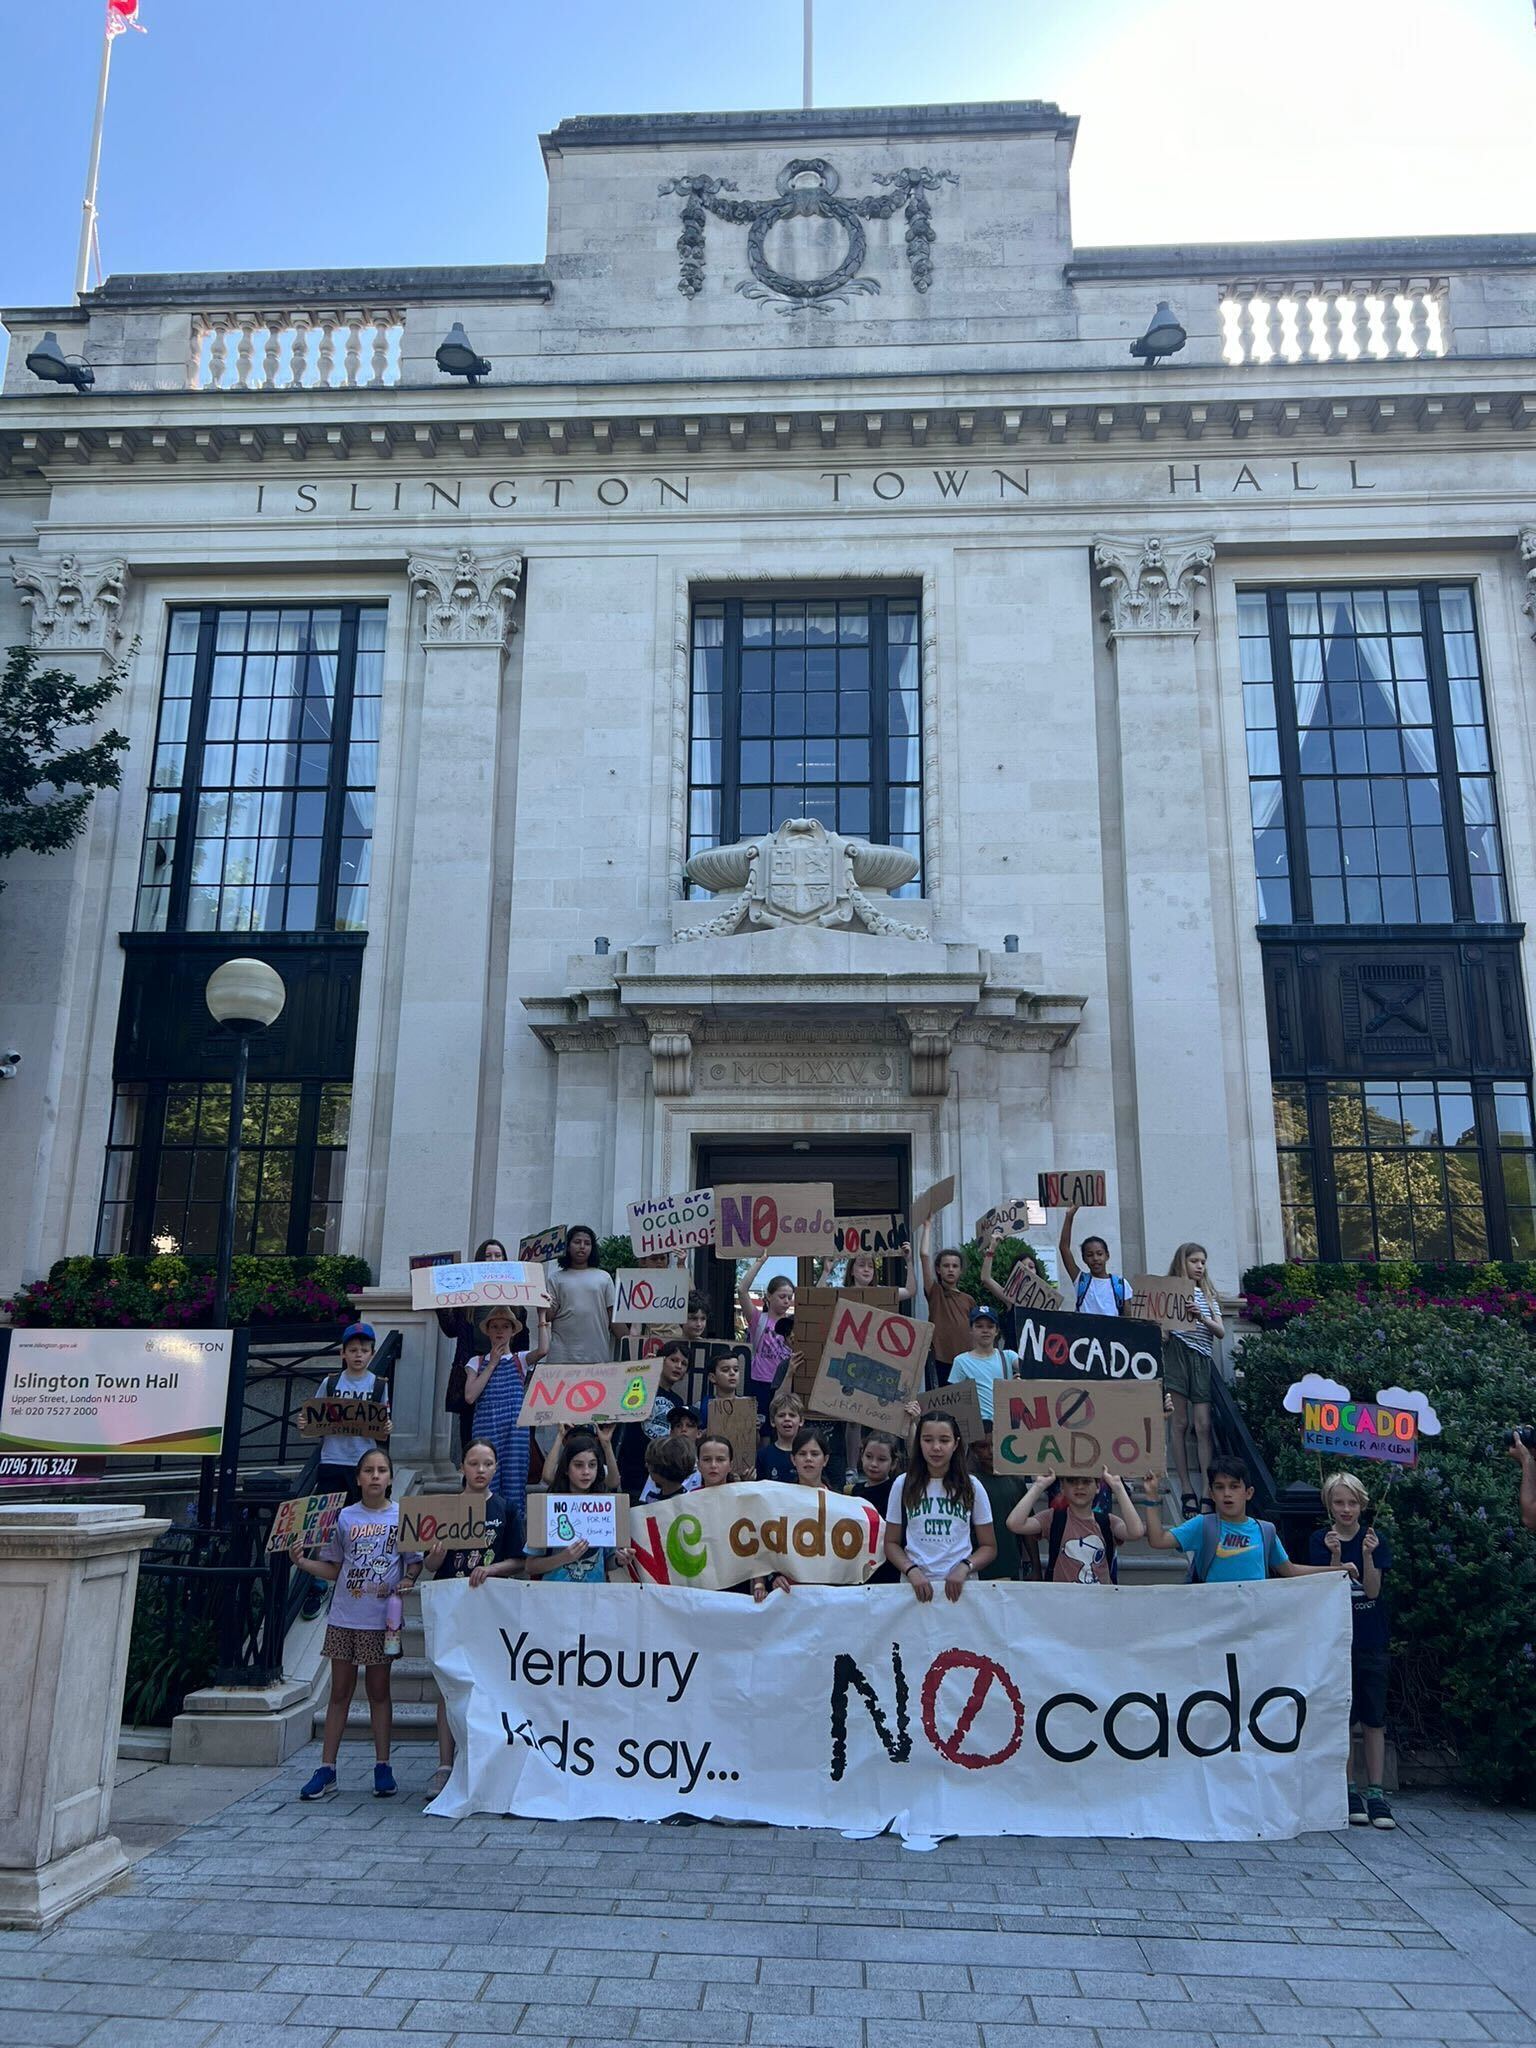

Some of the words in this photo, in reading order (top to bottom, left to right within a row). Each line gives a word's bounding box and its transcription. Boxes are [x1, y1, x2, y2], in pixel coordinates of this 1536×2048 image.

[255, 476, 690, 513] ISLINGTON
[820, 468, 1031, 502] TOWN
[1166, 459, 1377, 494] HALL
[634, 1197, 675, 1217] What
[684, 1192, 712, 1204] are
[436, 1291, 480, 1305] OCADO
[483, 1283, 536, 1300] OUT
[1018, 1318, 1158, 1381] NOCADO
[13, 1373, 89, 1392] Islington
[95, 1373, 141, 1389] Town
[146, 1373, 179, 1389] Hall
[12, 1394, 37, 1406] Upper
[38, 1394, 68, 1405] Street,
[70, 1394, 102, 1404] London
[104, 1394, 116, 1404] N1
[118, 1394, 138, 1404] 2UD
[25, 1407, 44, 1416] 020
[47, 1407, 71, 1416] 7527
[73, 1407, 98, 1416] 2000
[1304, 1402, 1415, 1441] NOCADO
[1306, 1432, 1341, 1446] KEEP
[1370, 1440, 1387, 1451] AIR
[0, 1458, 27, 1475] 0796
[30, 1458, 48, 1474] 716
[51, 1458, 78, 1475] 3247
[553, 1501, 568, 1513] NO
[571, 1501, 612, 1513] AVOCADO
[276, 1512, 319, 1534] LEVE
[924, 1519, 953, 1536] CITY
[350, 1524, 388, 1542] DANCE
[1222, 1533, 1250, 1547] NIKE
[347, 1567, 371, 1579] HEART
[346, 1579, 365, 1589] OUT
[499, 1627, 699, 1702] Yerbury
[615, 1738, 740, 1793] say...
